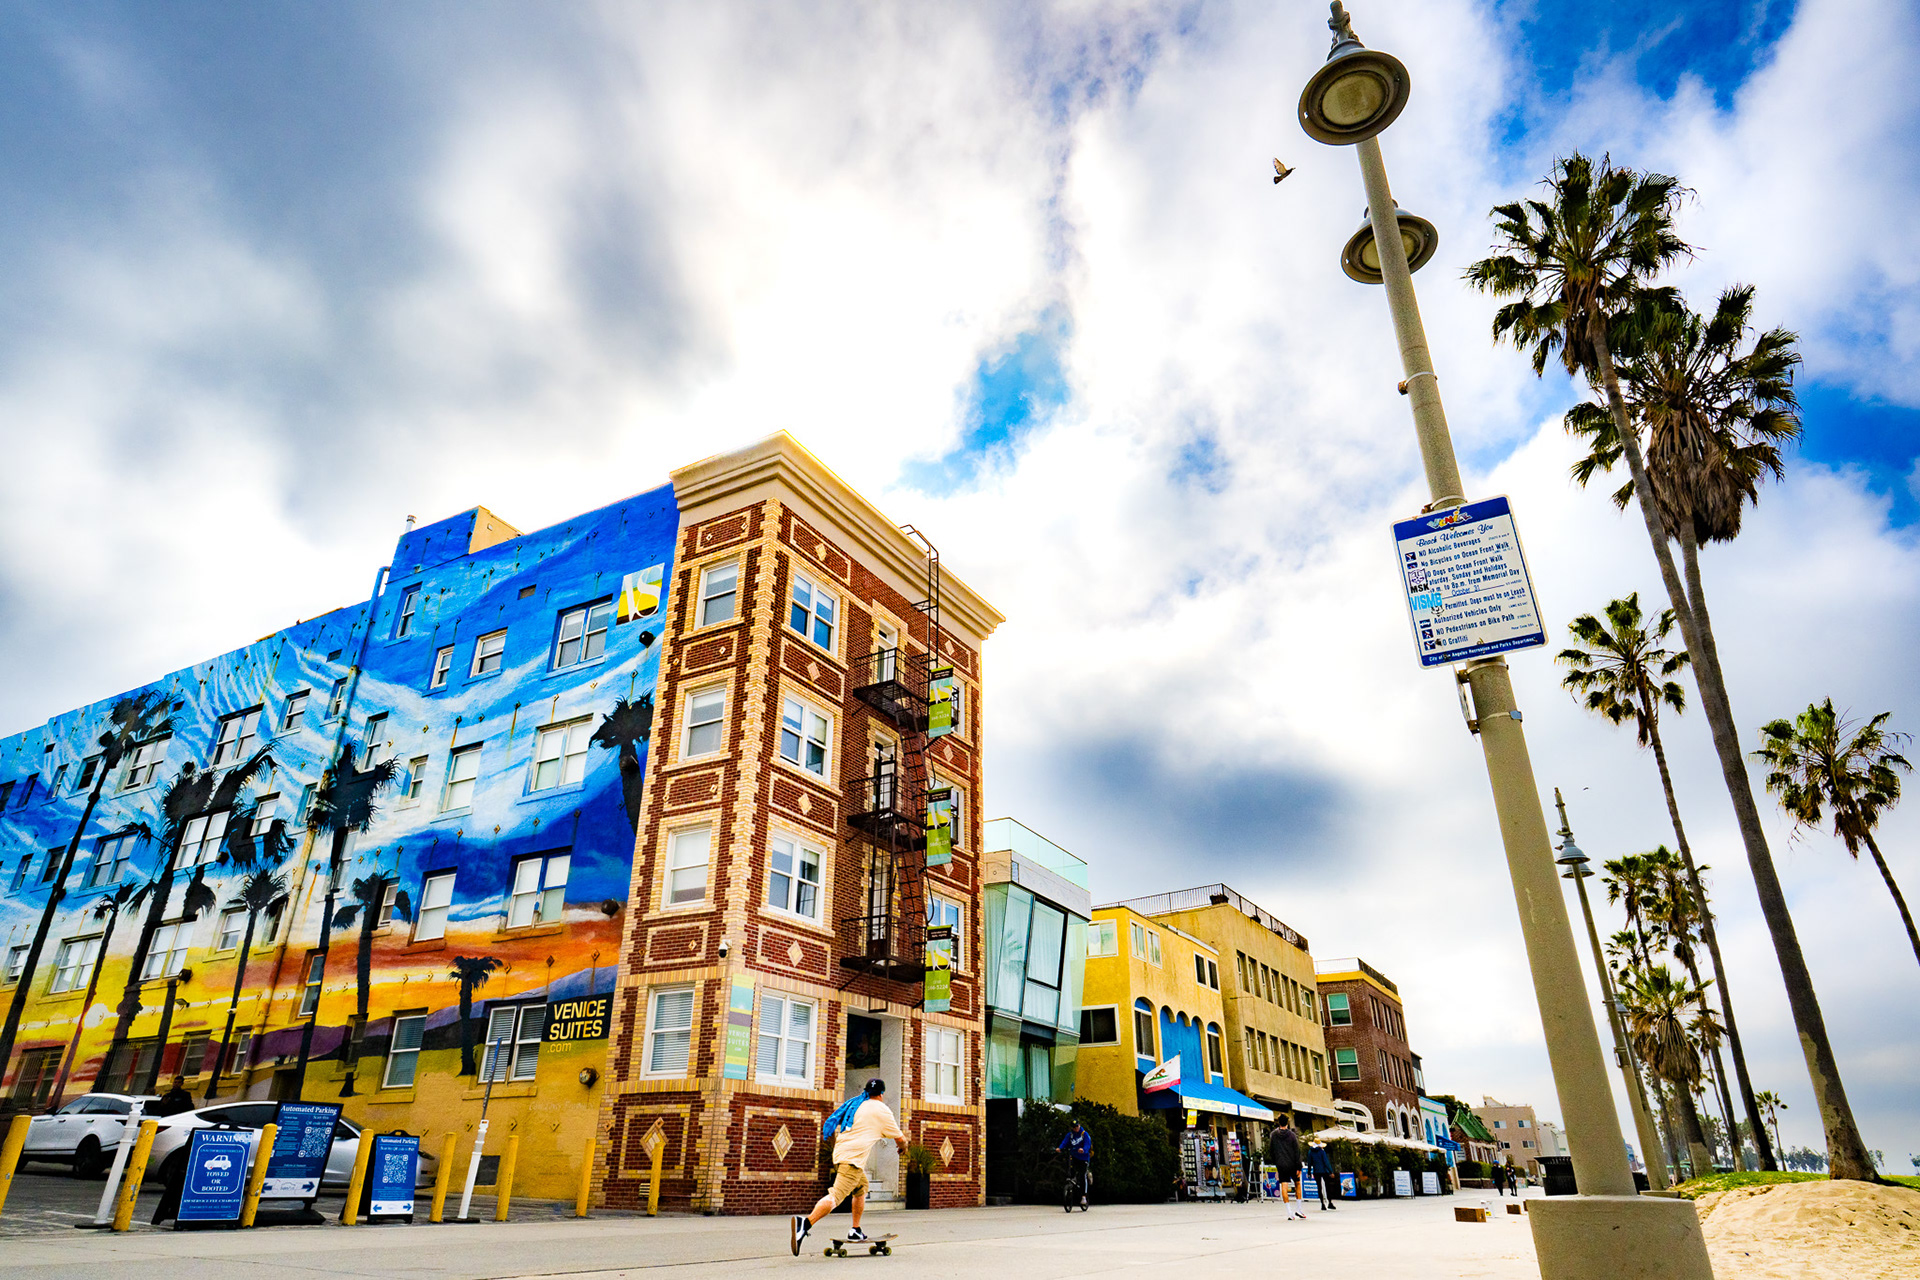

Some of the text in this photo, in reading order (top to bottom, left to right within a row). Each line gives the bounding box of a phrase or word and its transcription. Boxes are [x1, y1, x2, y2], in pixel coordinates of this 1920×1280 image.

[1416, 523, 1492, 546] Beach Welcomes You
[1428, 544, 1451, 554] Alcoholic
[1453, 538, 1480, 548] Beverages
[1429, 556, 1452, 565] Bicycles
[1461, 549, 1478, 557] Ocean
[1479, 545, 1494, 553] Front
[1473, 558, 1488, 566] Front
[1429, 576, 1450, 585] aturday,
[1451, 571, 1470, 580] Sunday
[1483, 563, 1507, 572] Holidays
[1482, 570, 1507, 581] Memorial
[1410, 583, 1429, 593] MSK
[1451, 588, 1470, 596] October
[1510, 587, 1524, 595] Leash
[1434, 612, 1462, 623] Authorized
[1464, 608, 1487, 617] Vehicles
[1445, 622, 1477, 633] Pedestrians
[1501, 613, 1514, 621] Path
[1448, 634, 1468, 644] Graffiti
[554, 1000, 606, 1020] VENICE
[549, 1020, 602, 1040] SUITES
[728, 1030, 749, 1038] VENICE
[547, 1042, 572, 1053] .com
[728, 1038, 749, 1046] SUITES
[314, 1106, 337, 1115] Parking
